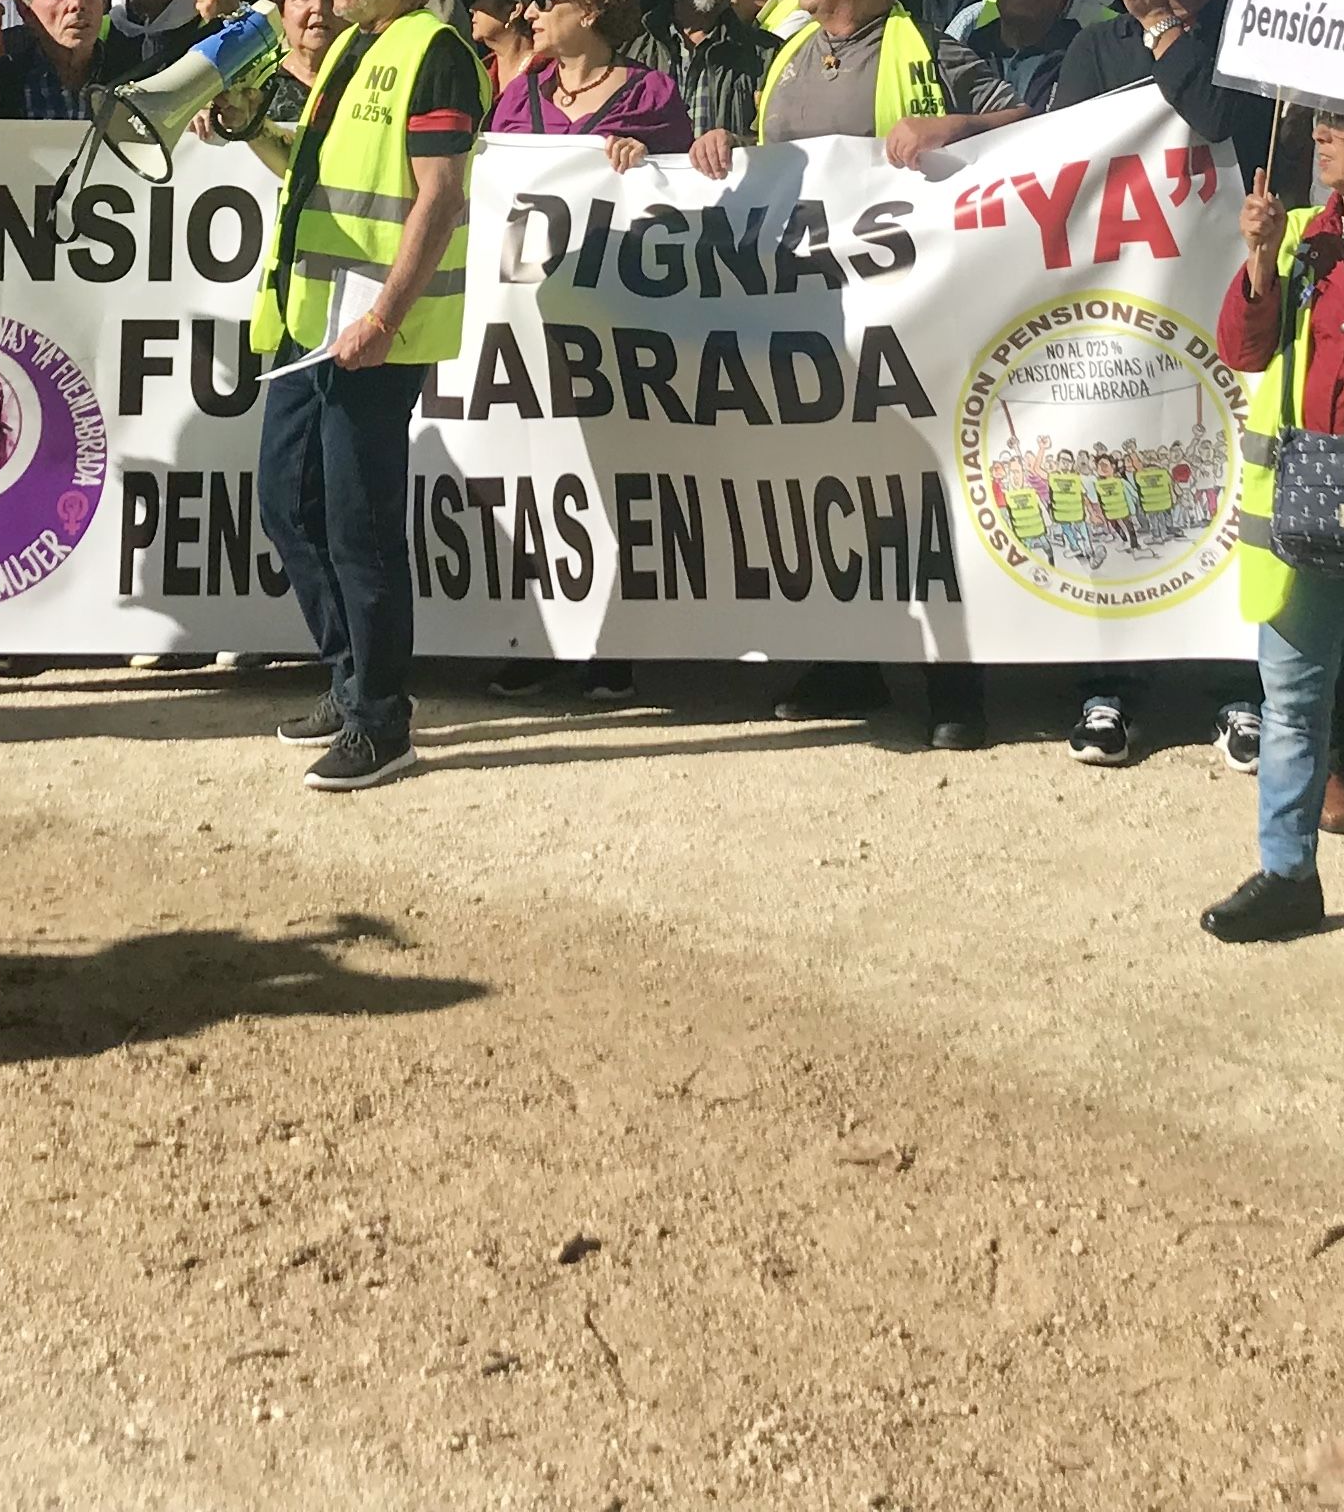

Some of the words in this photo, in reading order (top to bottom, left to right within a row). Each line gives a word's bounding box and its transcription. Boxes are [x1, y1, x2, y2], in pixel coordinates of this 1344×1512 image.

[365, 65, 398, 92] NO
[368, 91, 380, 104] AL
[498, 193, 918, 298] DIGNAS
[1045, 342, 1064, 359] NO
[1068, 342, 1083, 358] AL
[118, 318, 937, 426] FULABRADA
[992, 300, 1179, 367] PENSIONES
[1185, 335, 1248, 439] DIGNA
[1007, 360, 1086, 386] PENSIONES
[1089, 357, 1142, 378] DIGNAS
[1051, 379, 1150, 401] FUENLABRADA
[51, 360, 105, 486] FUENLABRADA
[120, 470, 595, 603] PENISTAS
[619, 472, 706, 603] EN
[731, 471, 962, 604] LUCHA
[1059, 571, 1195, 605] FUENLABRADA
